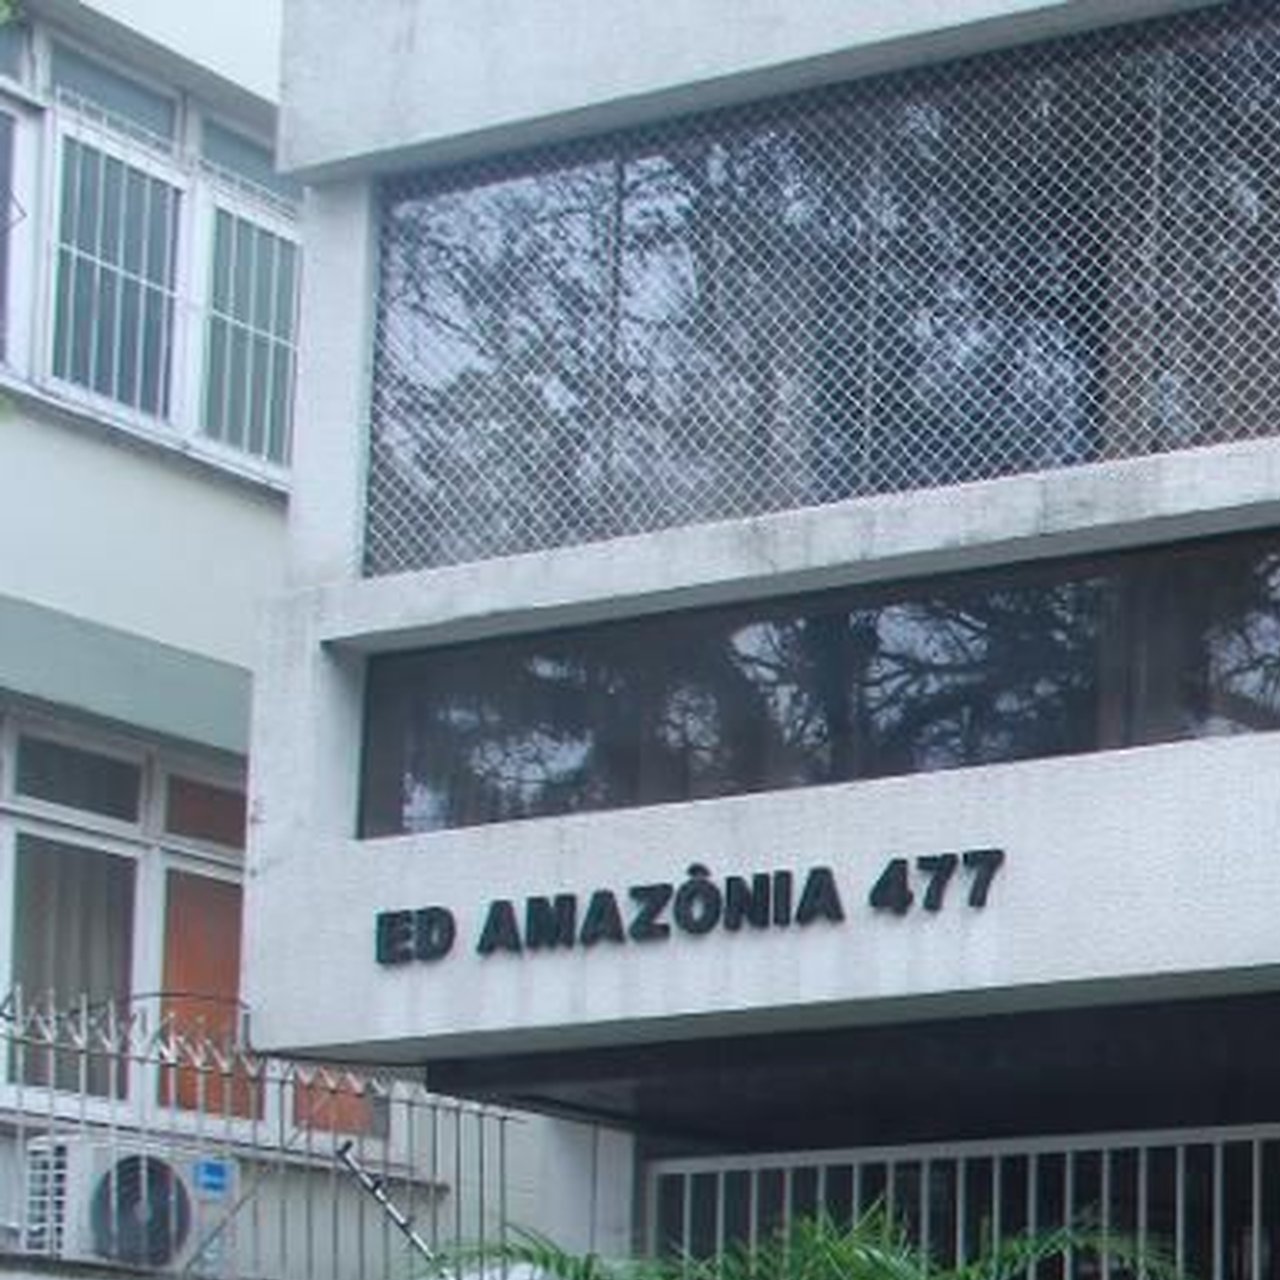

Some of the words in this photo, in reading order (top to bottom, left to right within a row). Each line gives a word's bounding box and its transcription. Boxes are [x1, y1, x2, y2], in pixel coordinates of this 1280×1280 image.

[376, 907, 456, 966] ED
[476, 863, 845, 955] AMAZÔNIA
[868, 849, 1005, 917] 477
